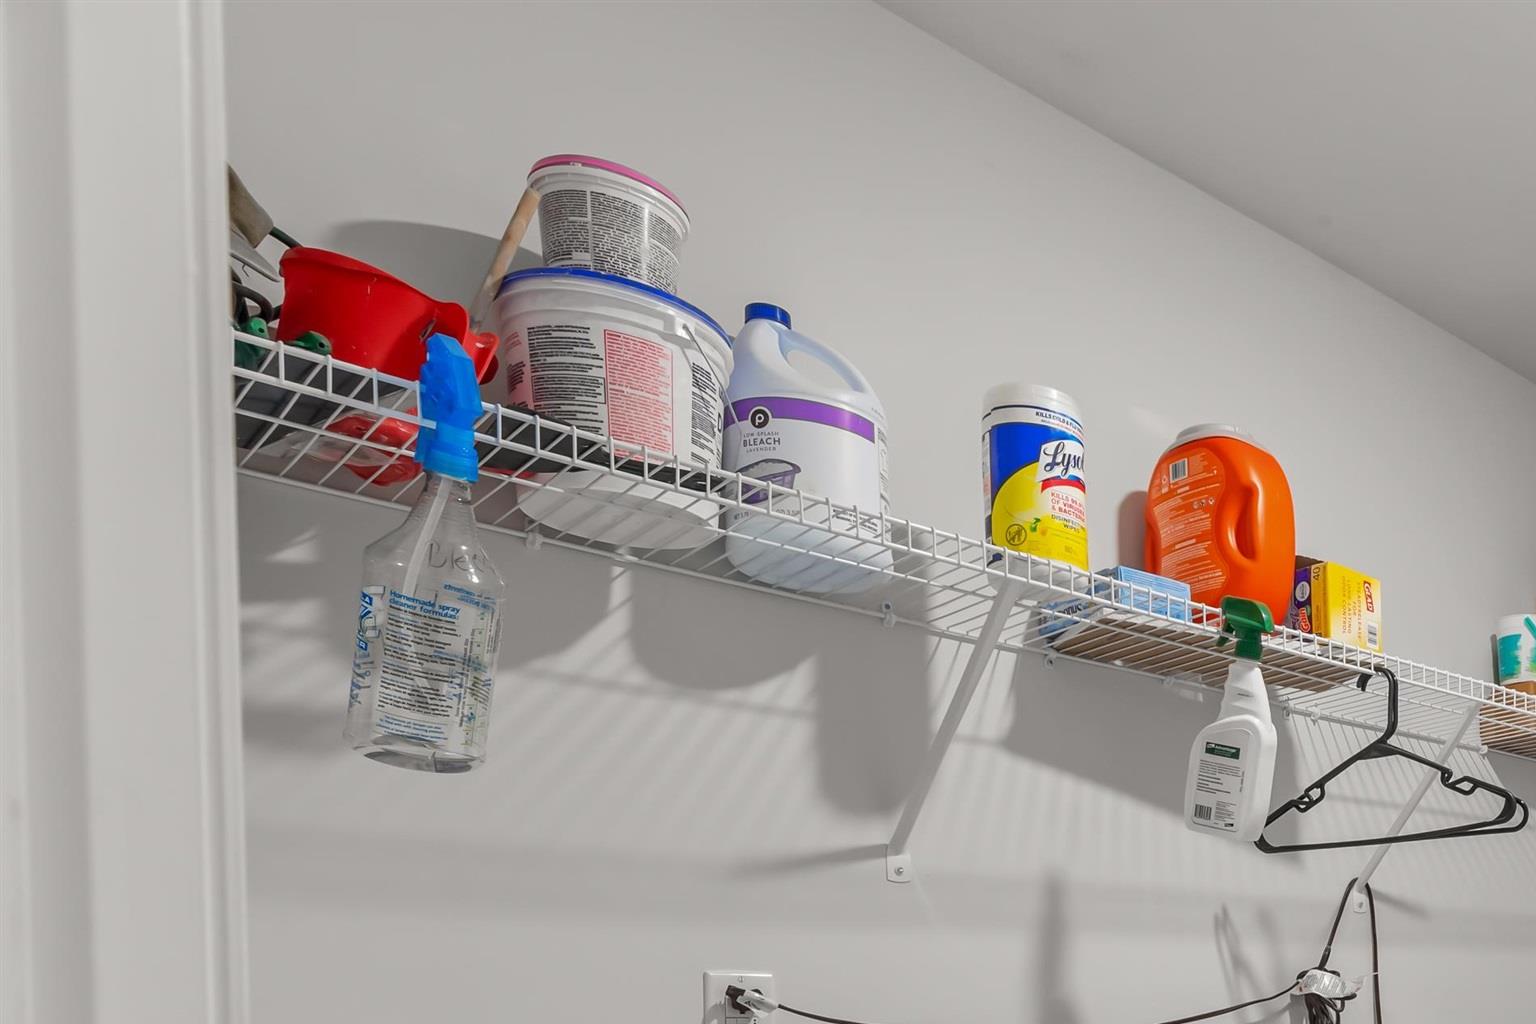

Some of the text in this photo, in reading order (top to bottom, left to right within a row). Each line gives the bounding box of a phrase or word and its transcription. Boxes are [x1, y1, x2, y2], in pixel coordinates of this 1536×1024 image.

[1036, 411, 1052, 419] KILLS
[743, 437, 781, 447] BLEACH
[390, 590, 436, 607] Homemade
[438, 603, 460, 614] spray
[1364, 581, 1374, 612] GLAD
[389, 598, 418, 611] cleaner
